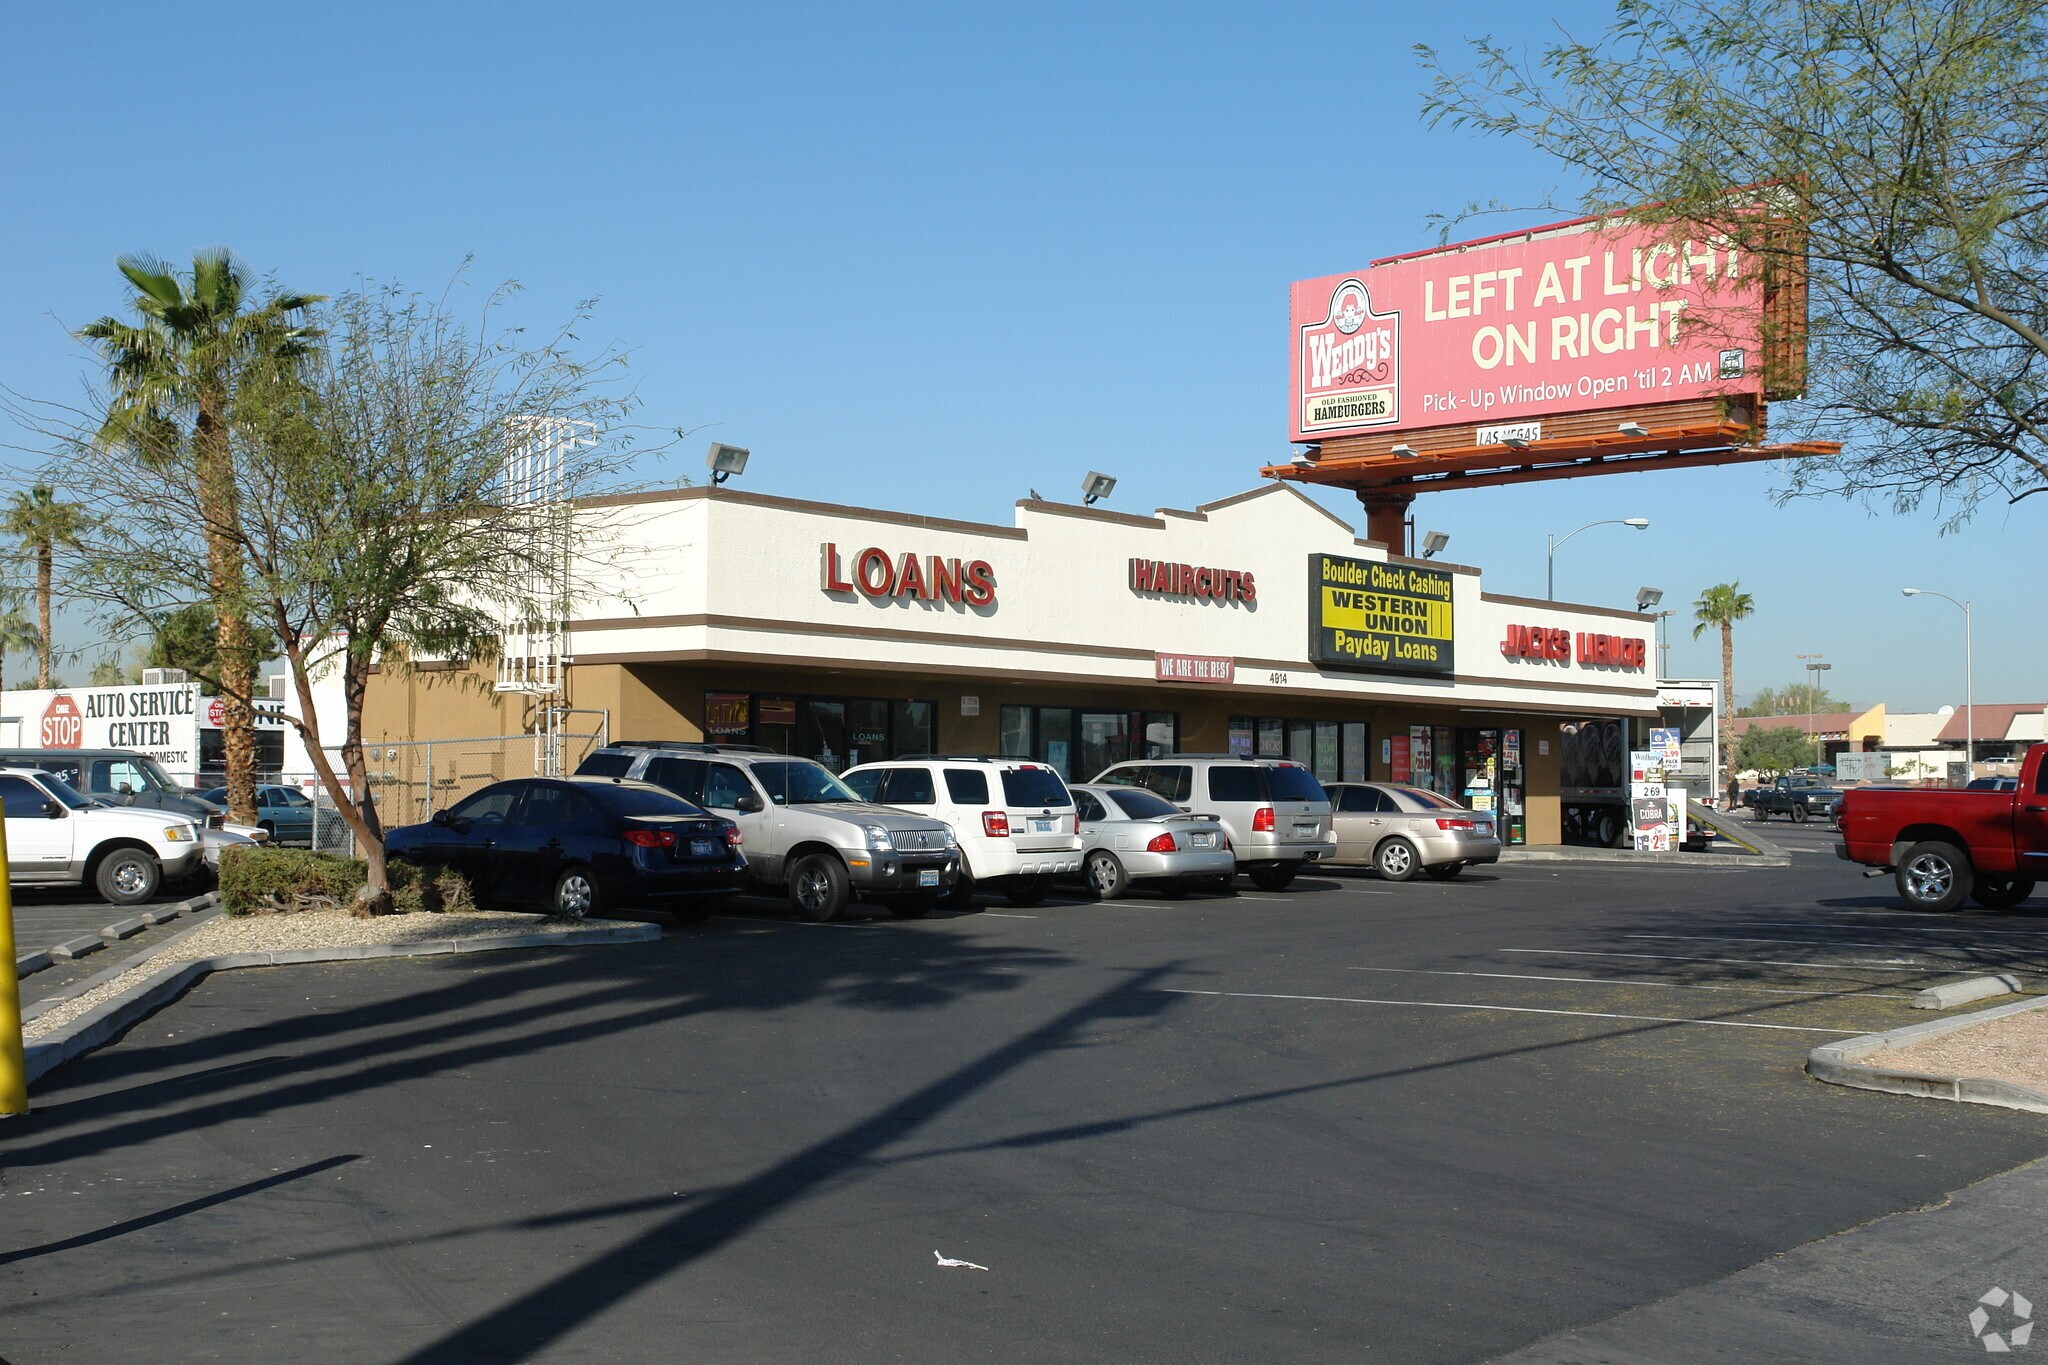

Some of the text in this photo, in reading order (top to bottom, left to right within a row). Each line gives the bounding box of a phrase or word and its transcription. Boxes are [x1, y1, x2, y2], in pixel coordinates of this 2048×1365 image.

[1424, 233, 1739, 322] LEFT AT LIGHT
[1472, 299, 1687, 370] ON RIGHT
[1500, 379, 1571, 403] Window
[1578, 375, 1628, 399] Open
[1661, 367, 1673, 388] 2
[1679, 361, 1712, 386] AM
[1314, 401, 1386, 421] HAMBURGERS
[1322, 394, 1378, 406] OLD FASHIONED
[1479, 430, 1499, 446] LAS
[820, 542, 996, 607] LOANS
[1129, 558, 1257, 602] HAIRCUTS
[1322, 557, 1451, 601] Boulder Check Cashing
[1332, 590, 1428, 618] WESTERN
[1365, 613, 1428, 635] UNION
[1335, 630, 1438, 662] Payday Loans
[1576, 632, 1646, 668] LIQUOR
[1160, 658, 1230, 679] WE ARE THE BEST
[85, 690, 195, 719] AUTO SERVICE
[42, 716, 81, 746] STOP
[108, 721, 170, 748] CENTER
[709, 726, 746, 736] LOANS
[852, 732, 886, 742] LOANS
[1639, 809, 1663, 820] COBRA
